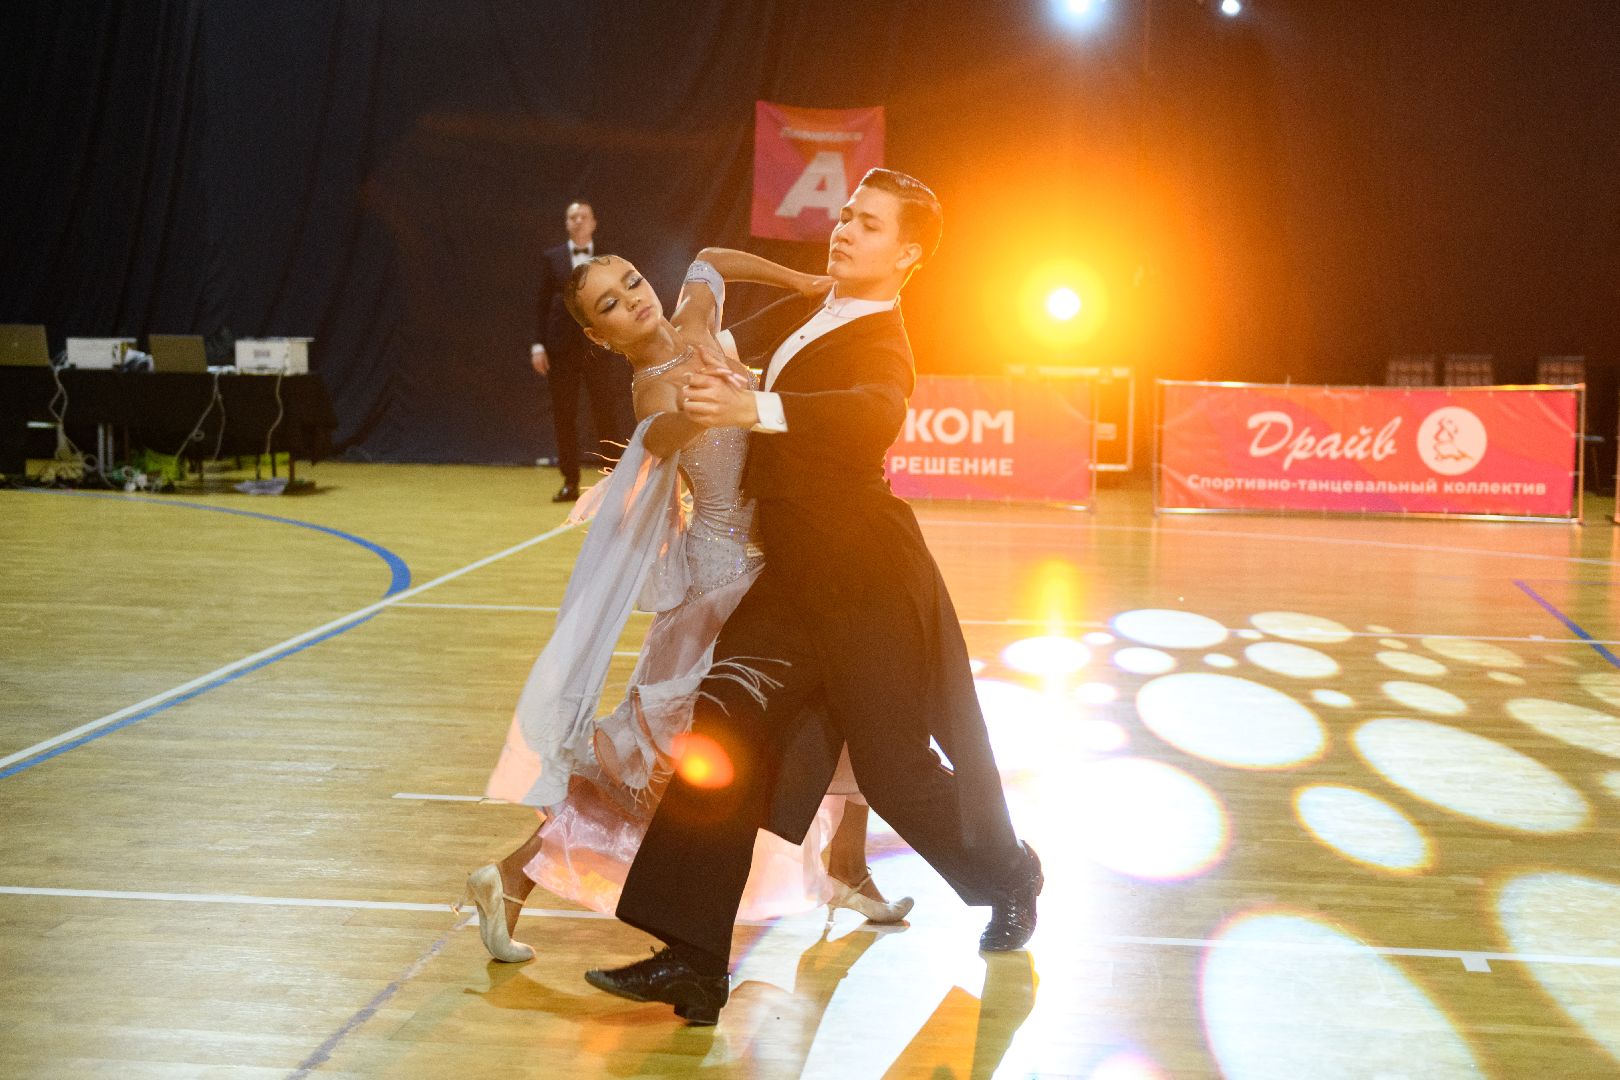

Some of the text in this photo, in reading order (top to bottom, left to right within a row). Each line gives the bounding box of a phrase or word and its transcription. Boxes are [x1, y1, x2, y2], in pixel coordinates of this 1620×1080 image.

[1247, 411, 1402, 471] Драйв
[891, 455, 1013, 476] РЕШЕНИЕ
[1187, 473, 1546, 497] Спортивно-танцевальный коллектив
